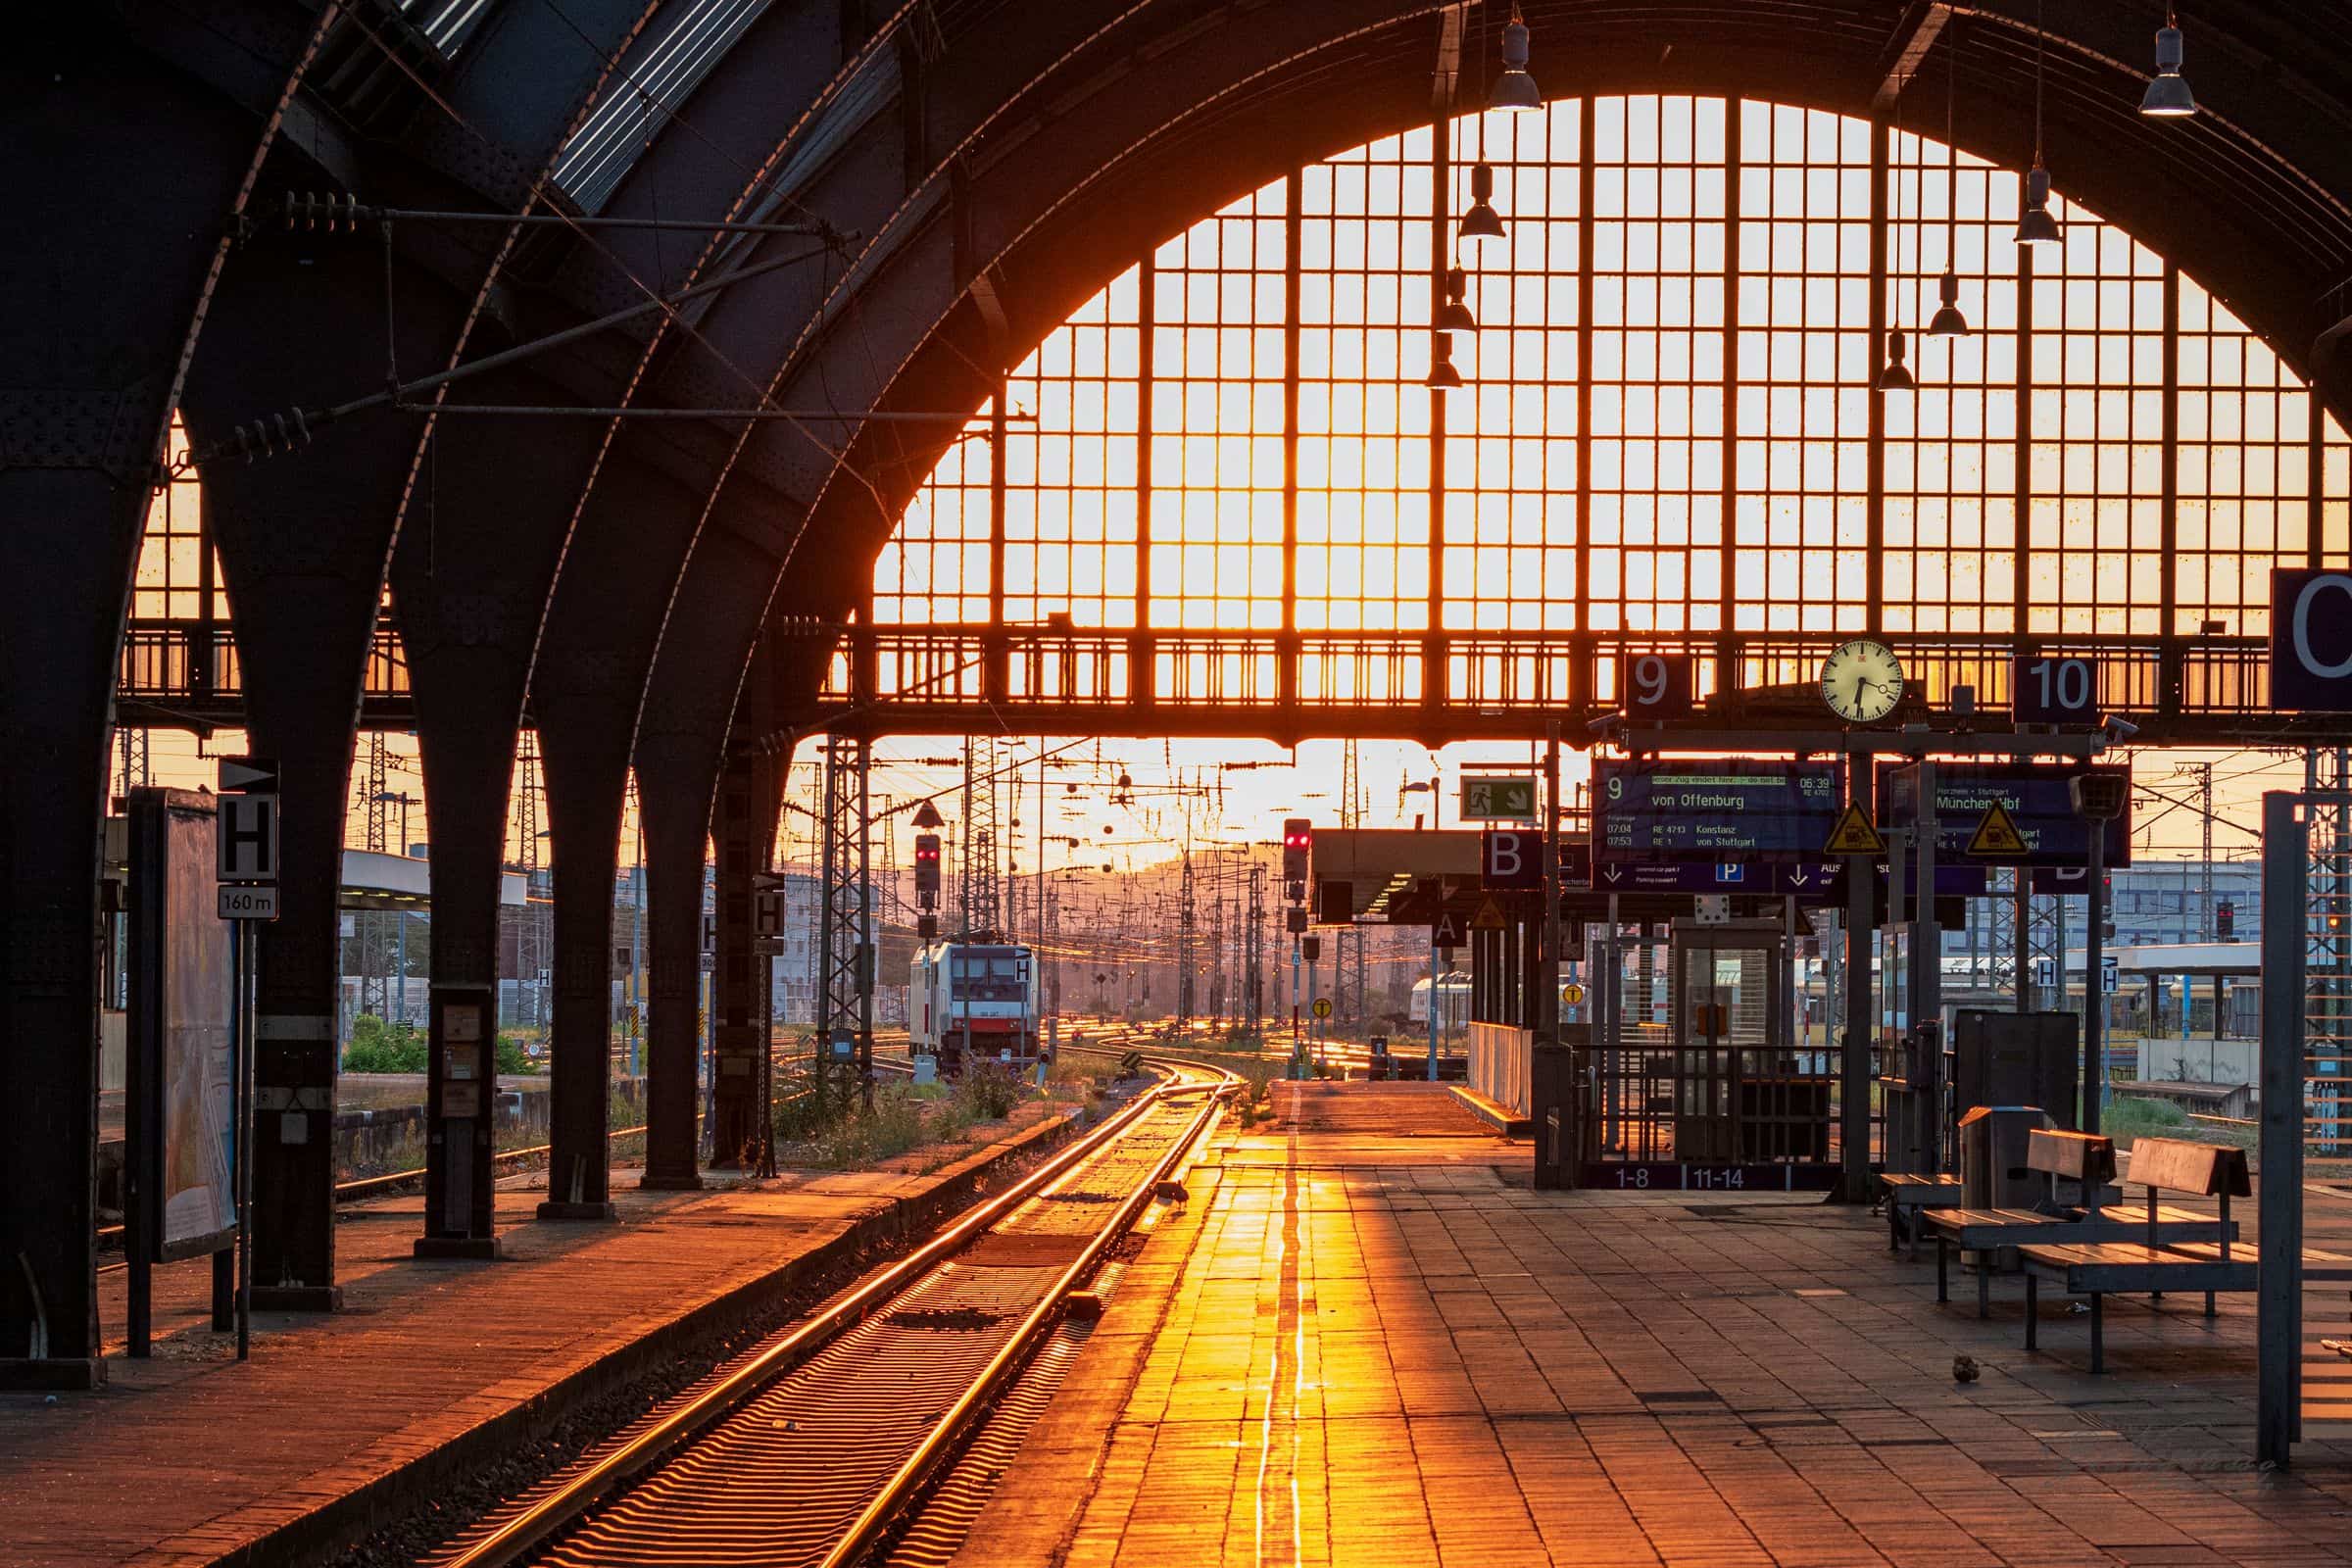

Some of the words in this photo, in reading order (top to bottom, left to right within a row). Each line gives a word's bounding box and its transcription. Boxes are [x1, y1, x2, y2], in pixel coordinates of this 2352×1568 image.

[1636, 655, 1667, 705] 9
[2031, 660, 2089, 709] 10
[1608, 777, 1622, 800] 9
[1799, 778, 1829, 789] 06:39
[1978, 788, 2009, 797] Stuttgart
[1651, 796, 1675, 806] von
[1681, 794, 1744, 809] Offenburg
[1936, 797, 1991, 809] München
[224, 802, 270, 872] H
[1696, 825, 1737, 834] Konstanz
[2019, 828, 2040, 839] tgart
[1607, 836, 1632, 846] 07:53
[1716, 838, 1755, 849] Stuttgart
[1491, 833, 1522, 876] B
[1725, 863, 1738, 879] P
[224, 895, 251, 909] 160
[256, 899, 270, 909] m
[758, 896, 781, 932] H
[1435, 914, 1456, 940] A
[540, 969, 551, 986] H
[1016, 960, 1029, 981] H
[2039, 962, 2054, 985] H
[2103, 969, 2118, 991] H
[1616, 1168, 1648, 1188] 1-8
[1693, 1168, 1743, 1188] 11-14
